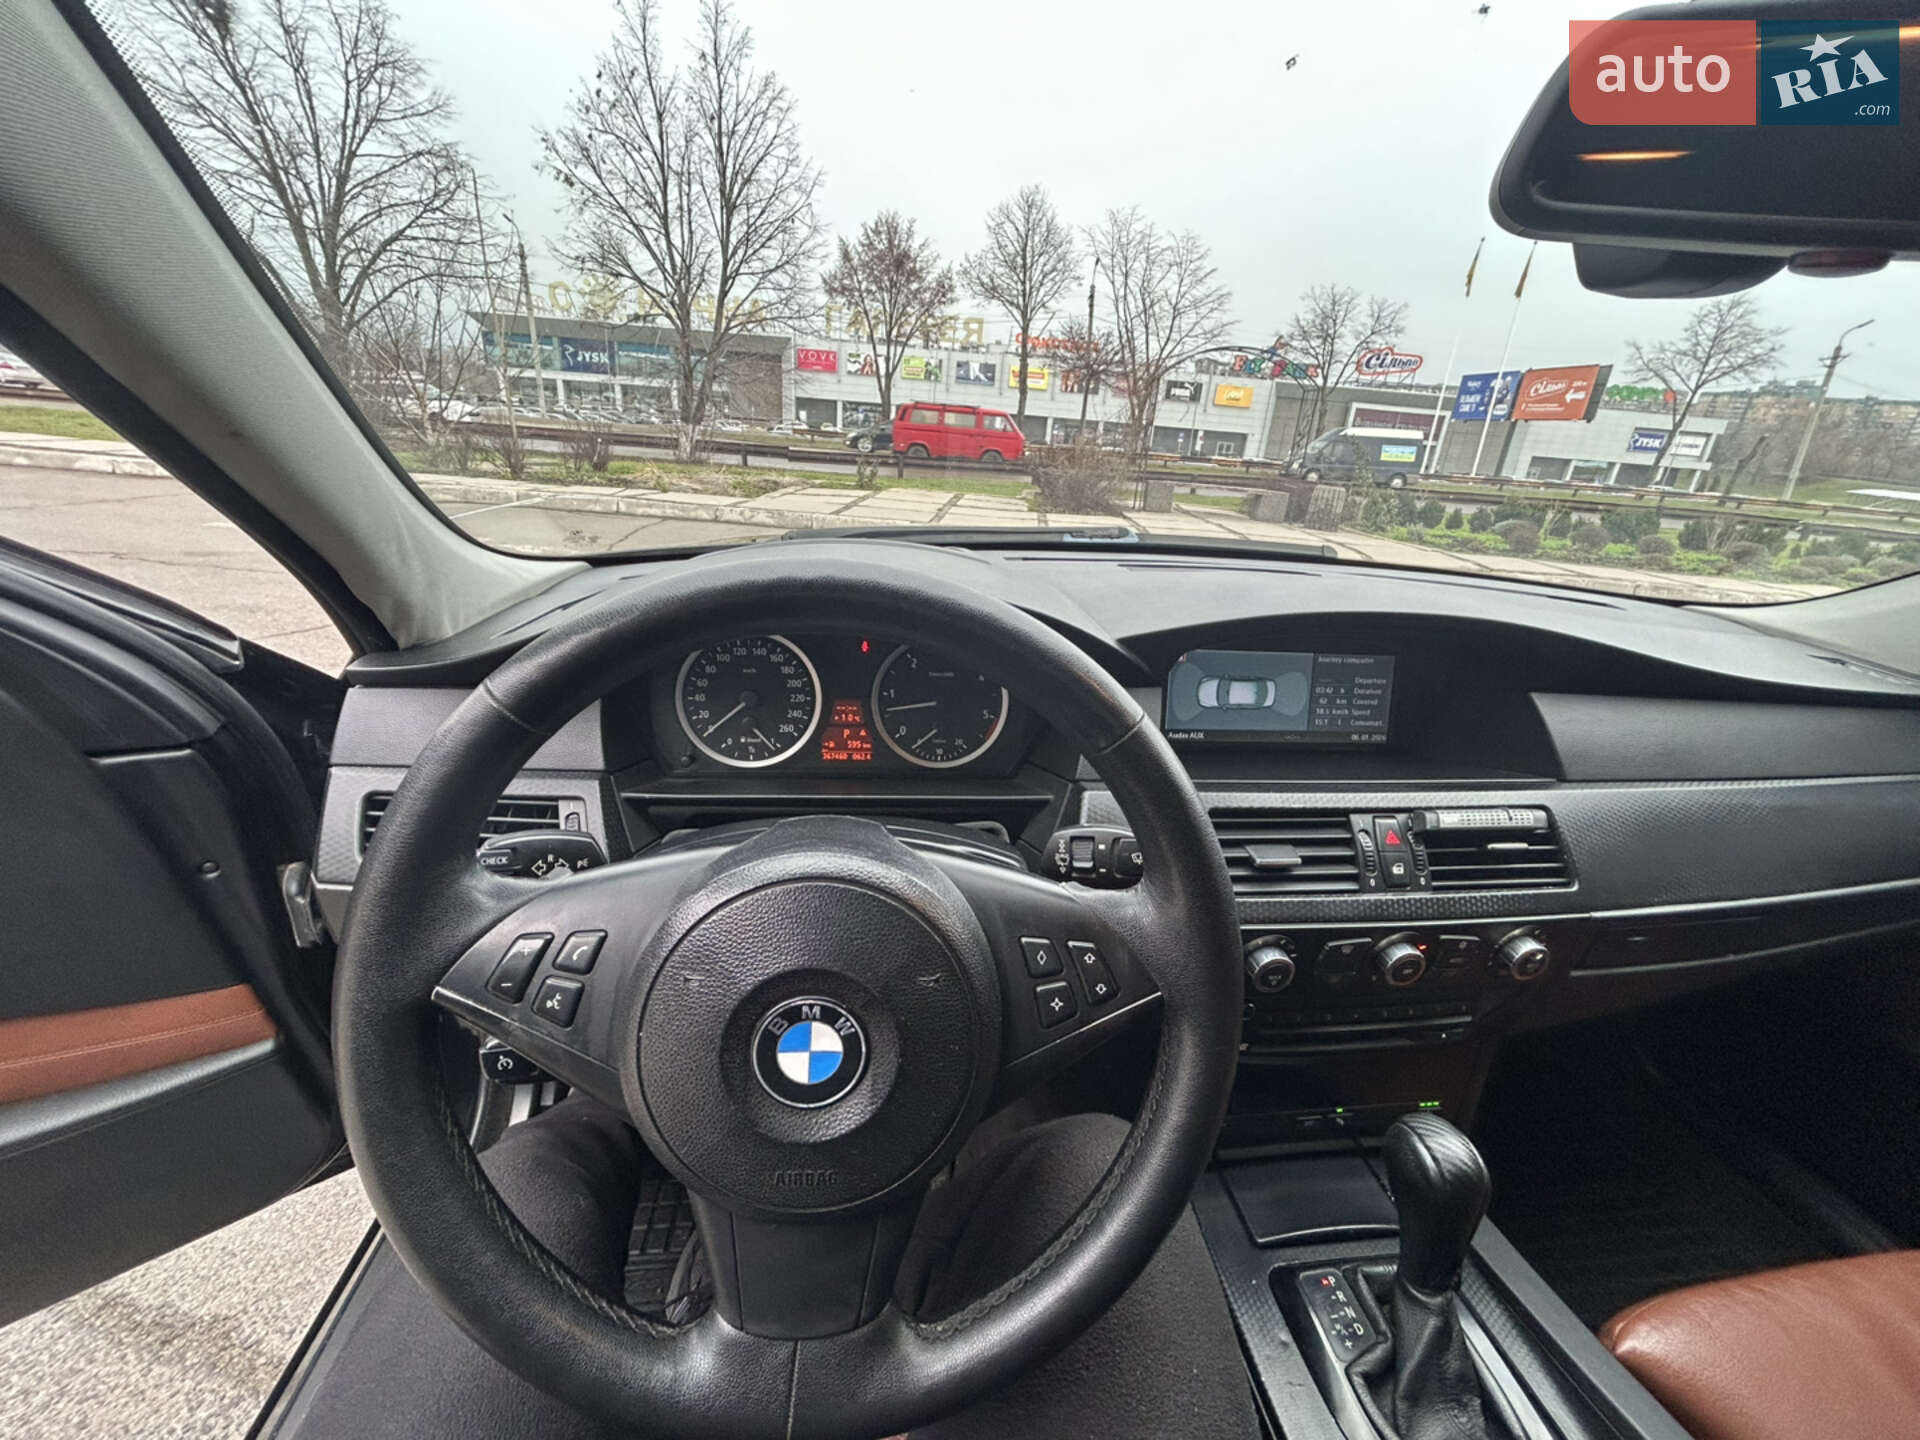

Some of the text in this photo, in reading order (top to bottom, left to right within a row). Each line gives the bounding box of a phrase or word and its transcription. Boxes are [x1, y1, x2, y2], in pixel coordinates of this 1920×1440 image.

[576, 350, 609, 363] JYSK
[1635, 437, 1662, 449] JYSK
[716, 654, 730, 662] 100
[770, 654, 784, 662] 160
[781, 666, 795, 674] 180
[787, 680, 802, 688] 200
[790, 694, 805, 702] 220
[699, 710, 709, 718] 20
[787, 710, 803, 718] 240
[983, 710, 989, 719] 5
[779, 725, 794, 733] 260
[900, 725, 906, 735] 0
[480, 856, 509, 865] CHECK
[768, 1005, 855, 1036] BMW
[775, 1170, 839, 1187] AIRBAG
[1328, 1275, 1336, 1287] P
[1336, 1290, 1347, 1302] R
[1344, 1306, 1356, 1319] N
[1353, 1323, 1364, 1335] D
